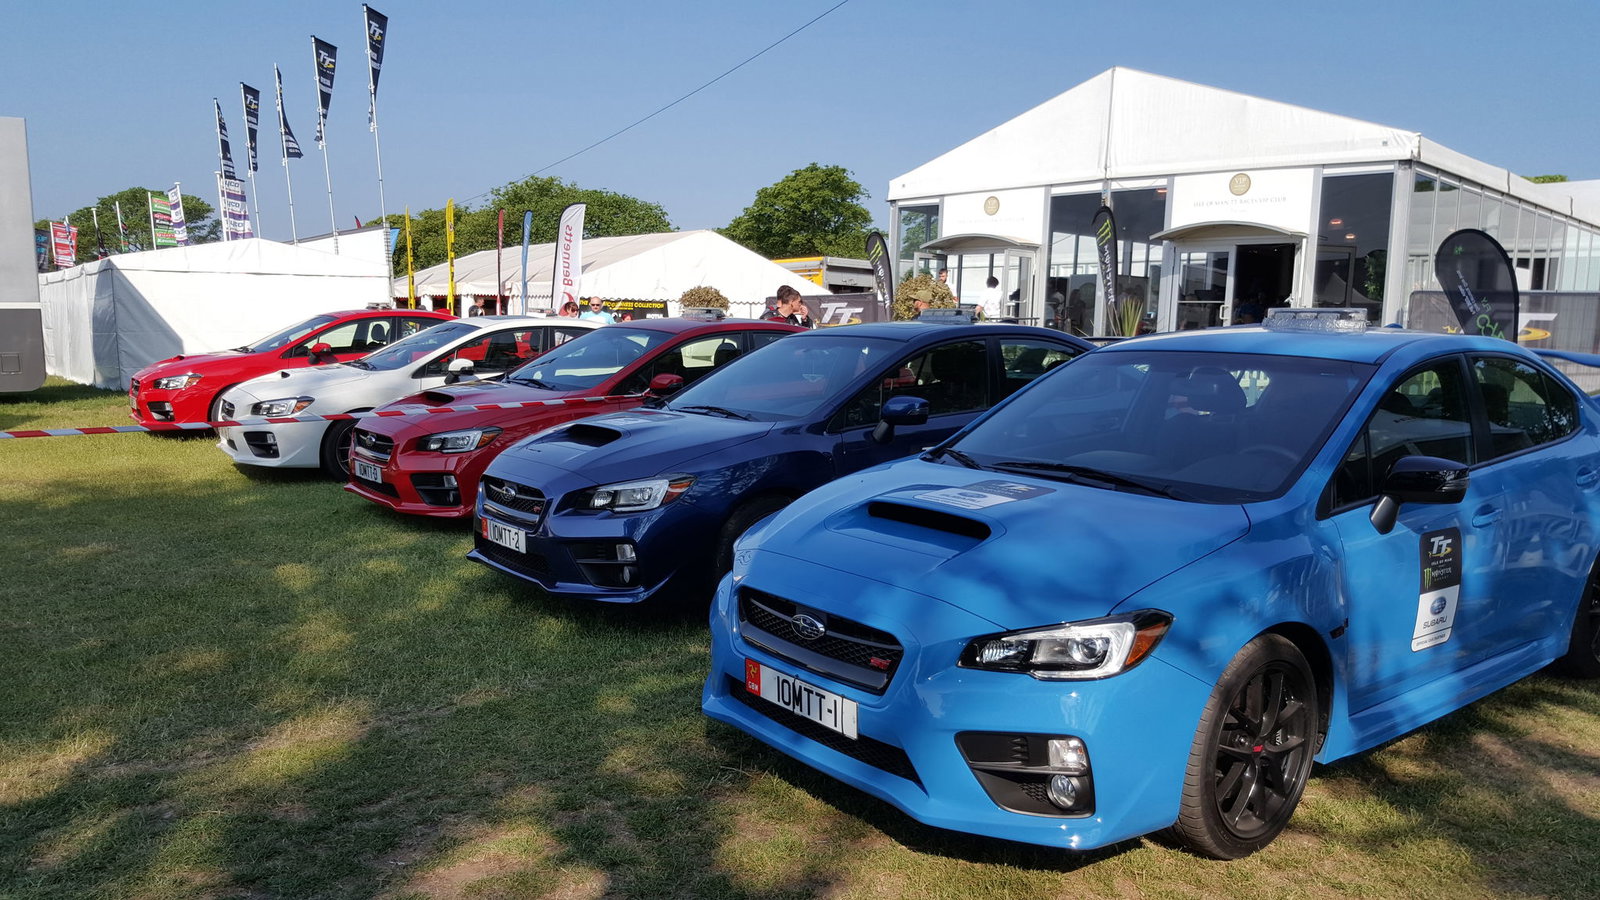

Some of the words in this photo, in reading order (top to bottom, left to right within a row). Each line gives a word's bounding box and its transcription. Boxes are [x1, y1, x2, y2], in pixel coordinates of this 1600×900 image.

[369, 20, 383, 40] TT
[318, 50, 335, 68] TT
[246, 94, 258, 109] TT
[820, 302, 864, 325] TT
[1431, 535, 1452, 557] TT
[1423, 616, 1447, 629] SUBARU
